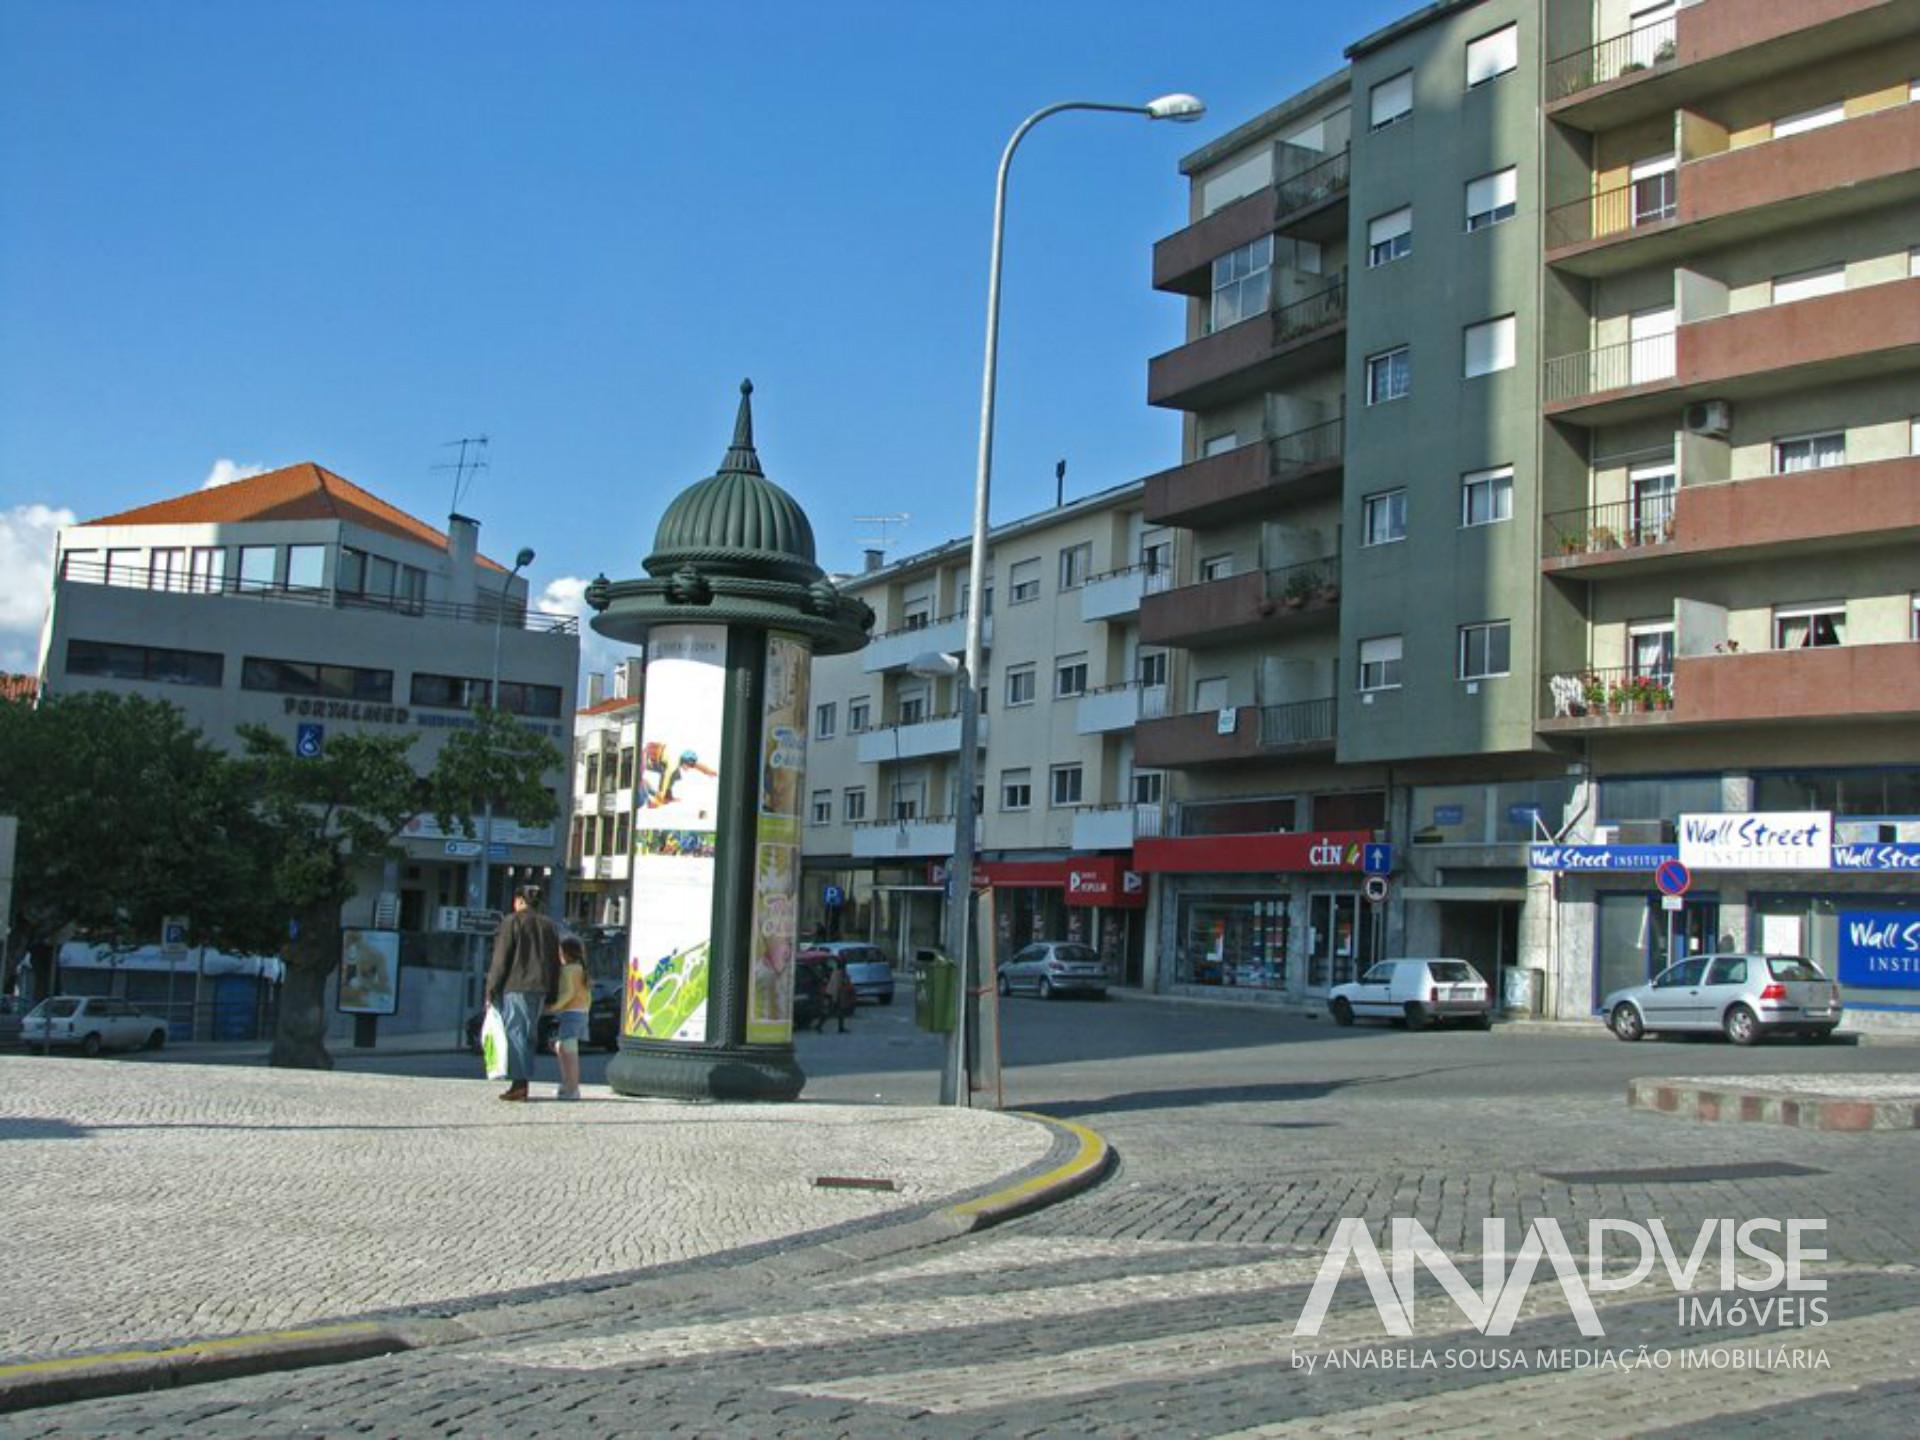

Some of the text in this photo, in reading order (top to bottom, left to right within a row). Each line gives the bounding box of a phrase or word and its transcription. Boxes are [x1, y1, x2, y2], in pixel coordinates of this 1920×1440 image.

[1687, 818, 1822, 848] Wall Street
[1531, 848, 1561, 866] Wall
[1562, 848, 1611, 869] Street
[1834, 846, 1876, 868] Wall
[1850, 919, 1899, 950] Wall
